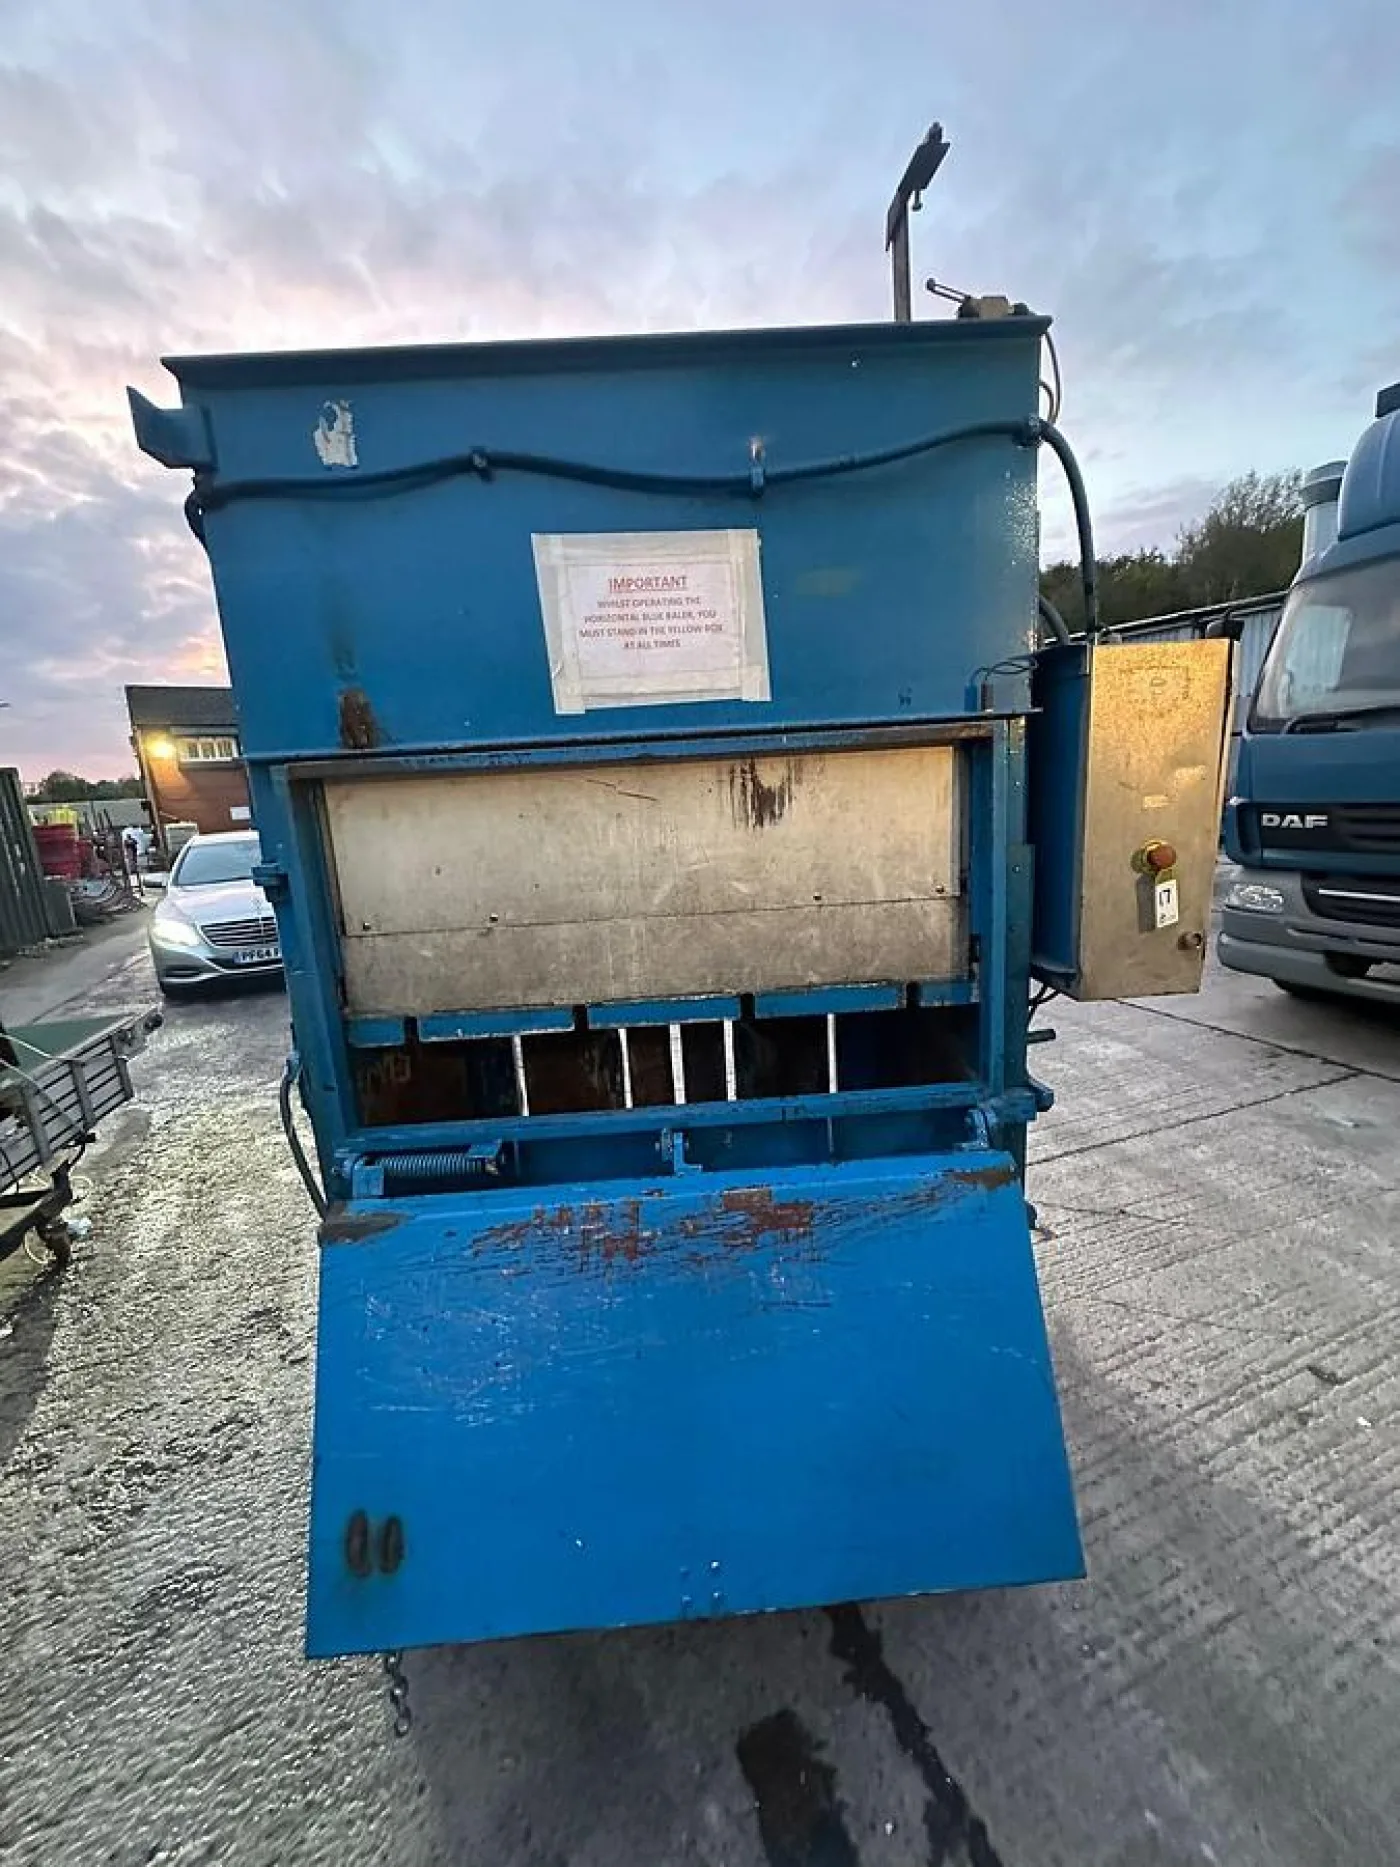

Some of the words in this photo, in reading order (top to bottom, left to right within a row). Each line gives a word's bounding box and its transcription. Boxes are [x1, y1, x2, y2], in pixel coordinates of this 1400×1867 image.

[609, 576, 687, 593] IMPORTANT
[597, 599, 629, 609] WHILST
[632, 598, 682, 608] OPERATING
[685, 596, 700, 605] THE
[584, 613, 639, 623] HORIZONTAL
[698, 610, 716, 619] YOU
[579, 629, 604, 638] MUST
[607, 627, 636, 637] STAND
[650, 626, 666, 635] THE
[668, 625, 701, 634] YELLOW
[638, 640, 652, 649] ALL
[654, 640, 681, 648] TIMES
[1261, 813, 1329, 829] DAF
